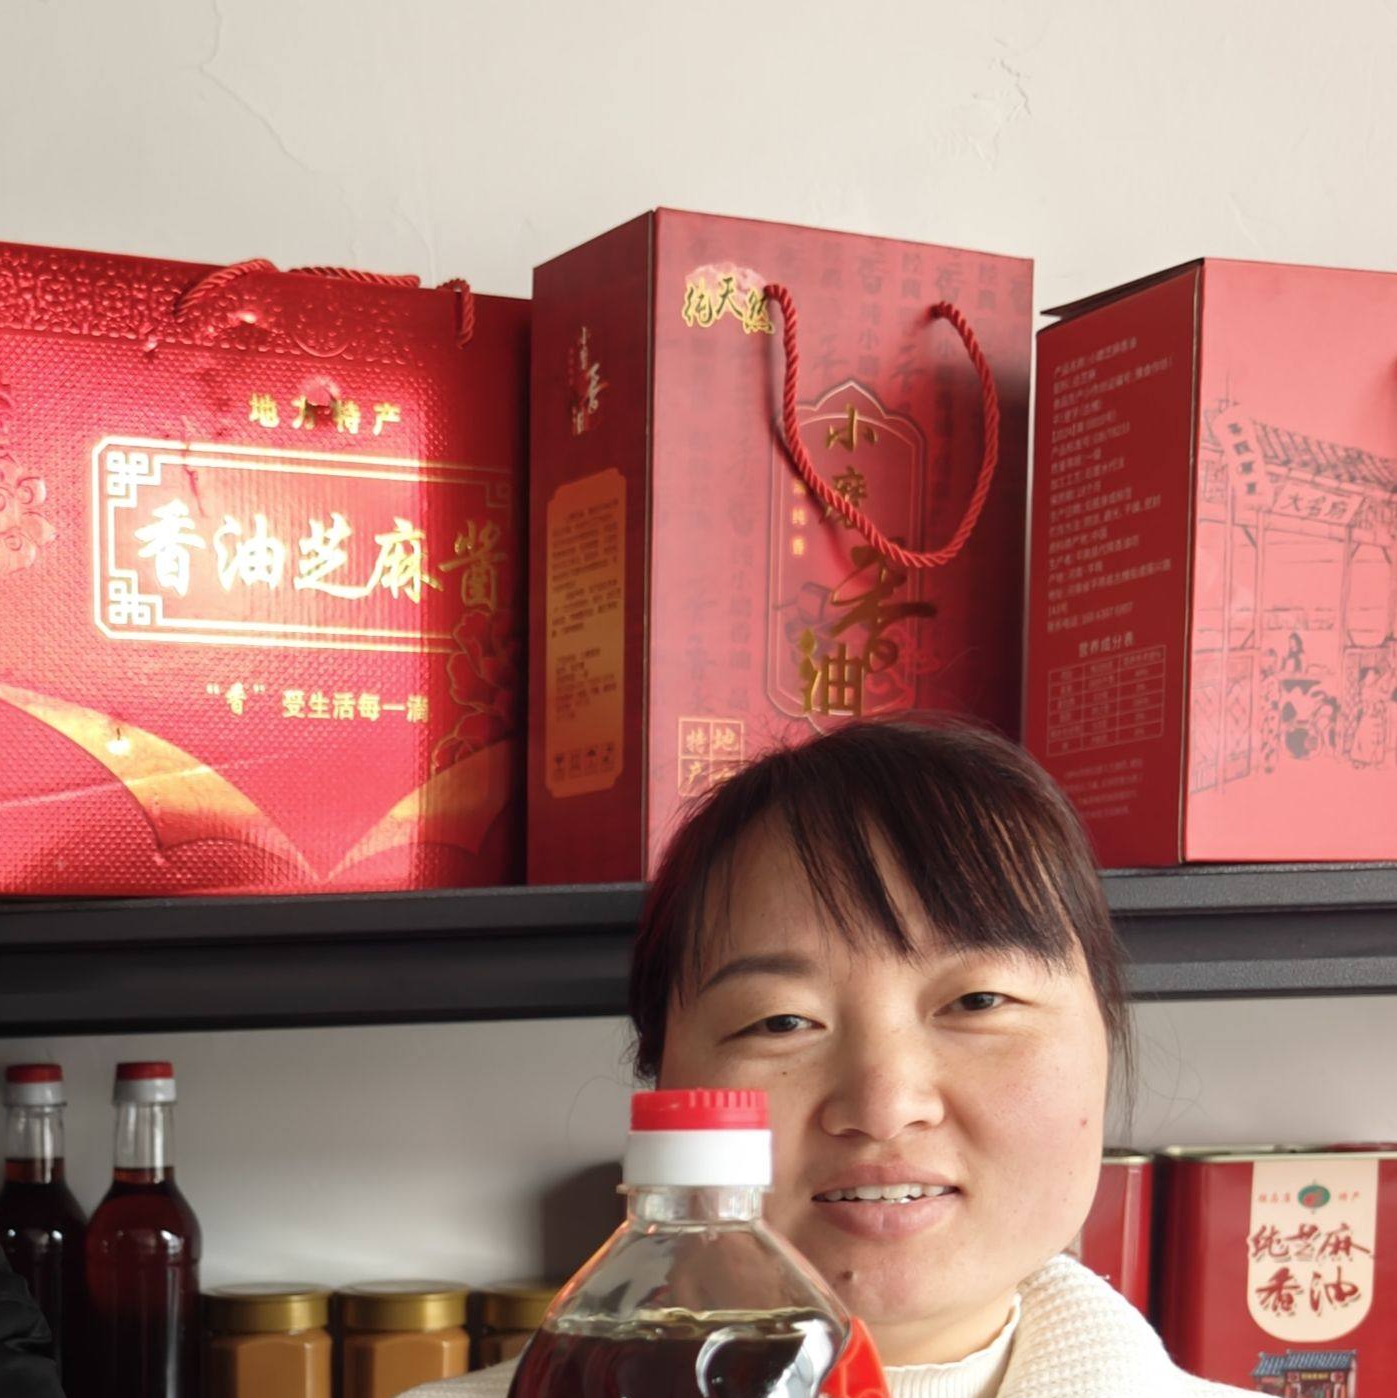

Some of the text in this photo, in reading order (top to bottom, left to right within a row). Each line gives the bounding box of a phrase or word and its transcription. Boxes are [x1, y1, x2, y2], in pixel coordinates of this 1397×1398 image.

[282, 689, 430, 723] 受生活每一滴
[1256, 1265, 1360, 1313] 香油
